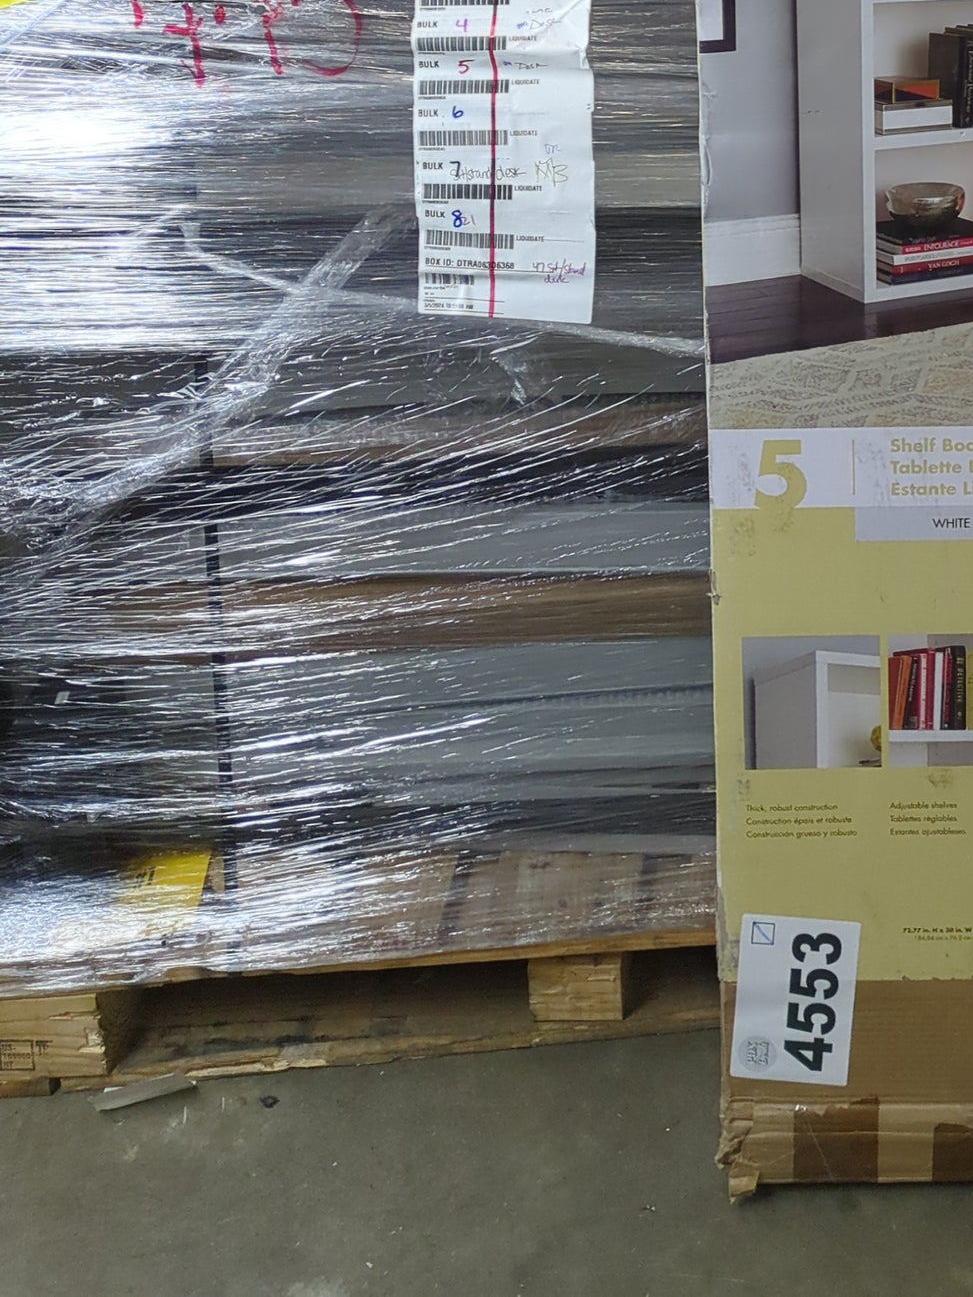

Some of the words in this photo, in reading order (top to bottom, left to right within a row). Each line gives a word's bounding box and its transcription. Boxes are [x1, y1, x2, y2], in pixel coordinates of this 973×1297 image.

[417, 20, 438, 28] BULK
[418, 60, 440, 69] BULK
[457, 59, 476, 75] 5
[418, 109, 439, 118] BULK
[452, 105, 464, 119] 6
[422, 161, 443, 170] BULK
[424, 210, 446, 218] BULK
[425, 257, 441, 265] BOX
[890, 436, 937, 453] Shelf
[890, 458, 964, 475] Tablette
[753, 438, 808, 509] 5
[890, 480, 957, 496] Estante
[932, 516, 971, 529] WHITE
[783, 932, 843, 1073] 4553
